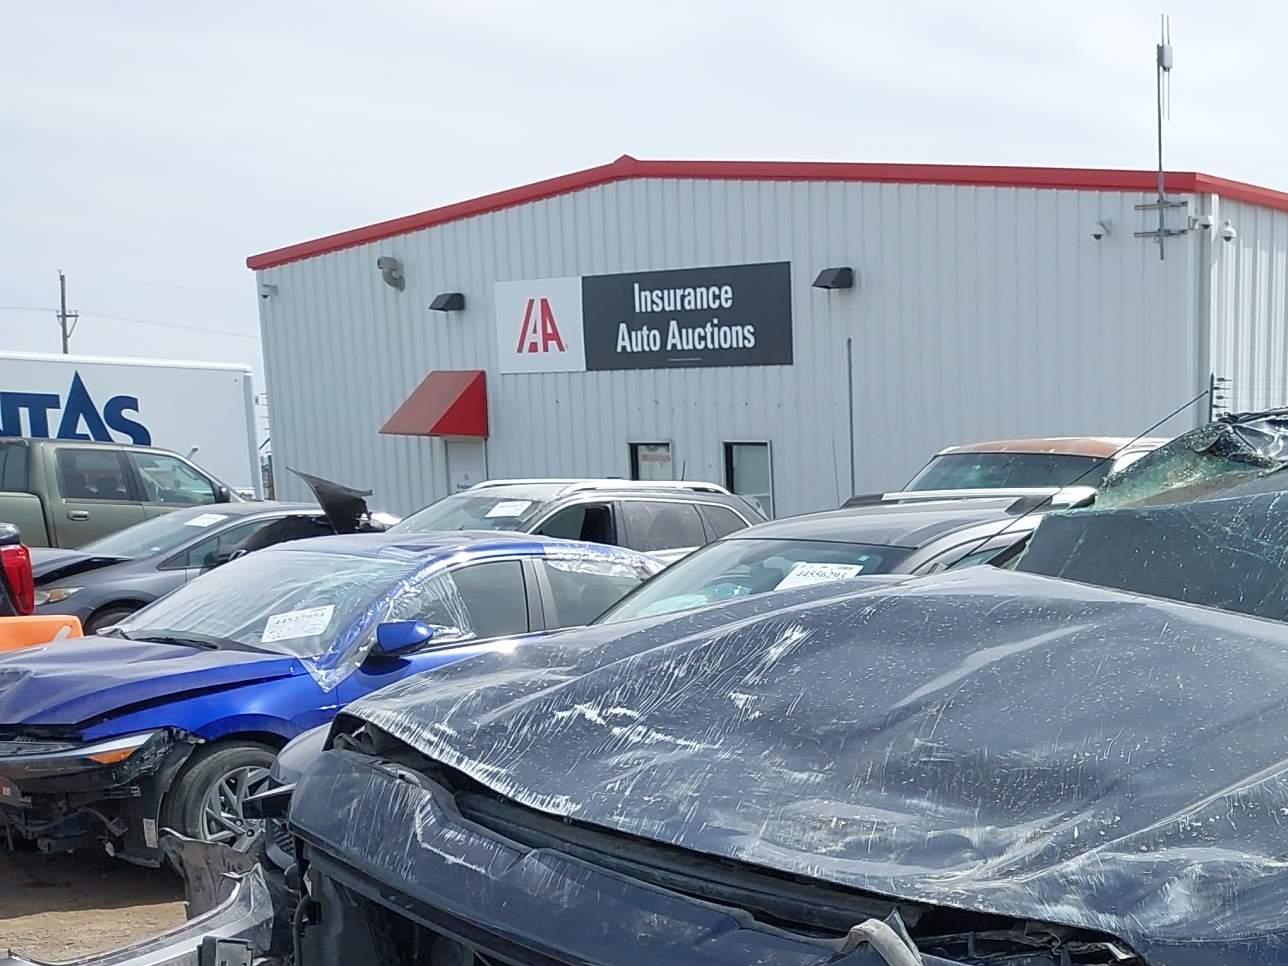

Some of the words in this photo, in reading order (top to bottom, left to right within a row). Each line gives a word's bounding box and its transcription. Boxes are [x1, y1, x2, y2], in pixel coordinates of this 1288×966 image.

[633, 282, 733, 313] Insurance
[616, 322, 661, 352] Auto
[666, 317, 756, 350] Auctions
